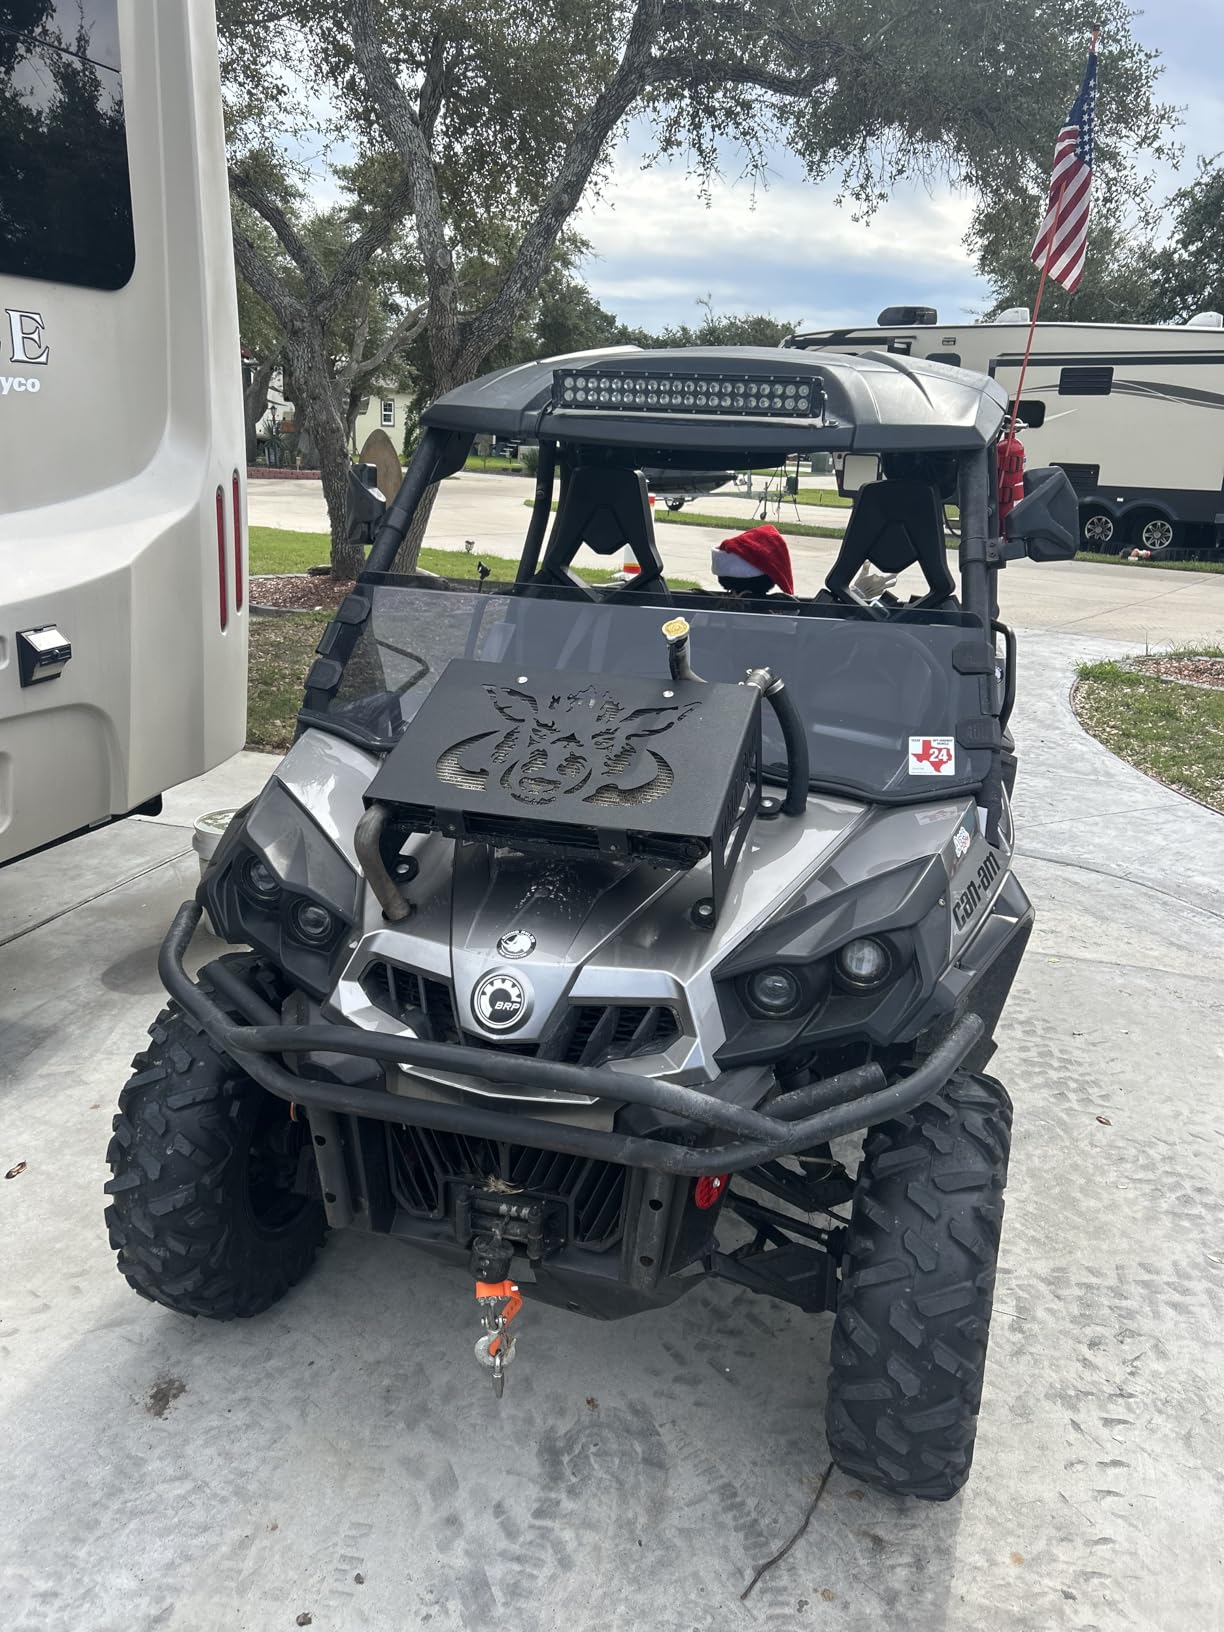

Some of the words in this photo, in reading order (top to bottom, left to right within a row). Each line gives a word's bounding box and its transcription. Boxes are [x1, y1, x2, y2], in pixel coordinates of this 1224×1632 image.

[0, 308, 50, 366] E
[0, 376, 41, 395] yco
[929, 748, 949, 762] 24
[494, 1000, 521, 1011] BRP
